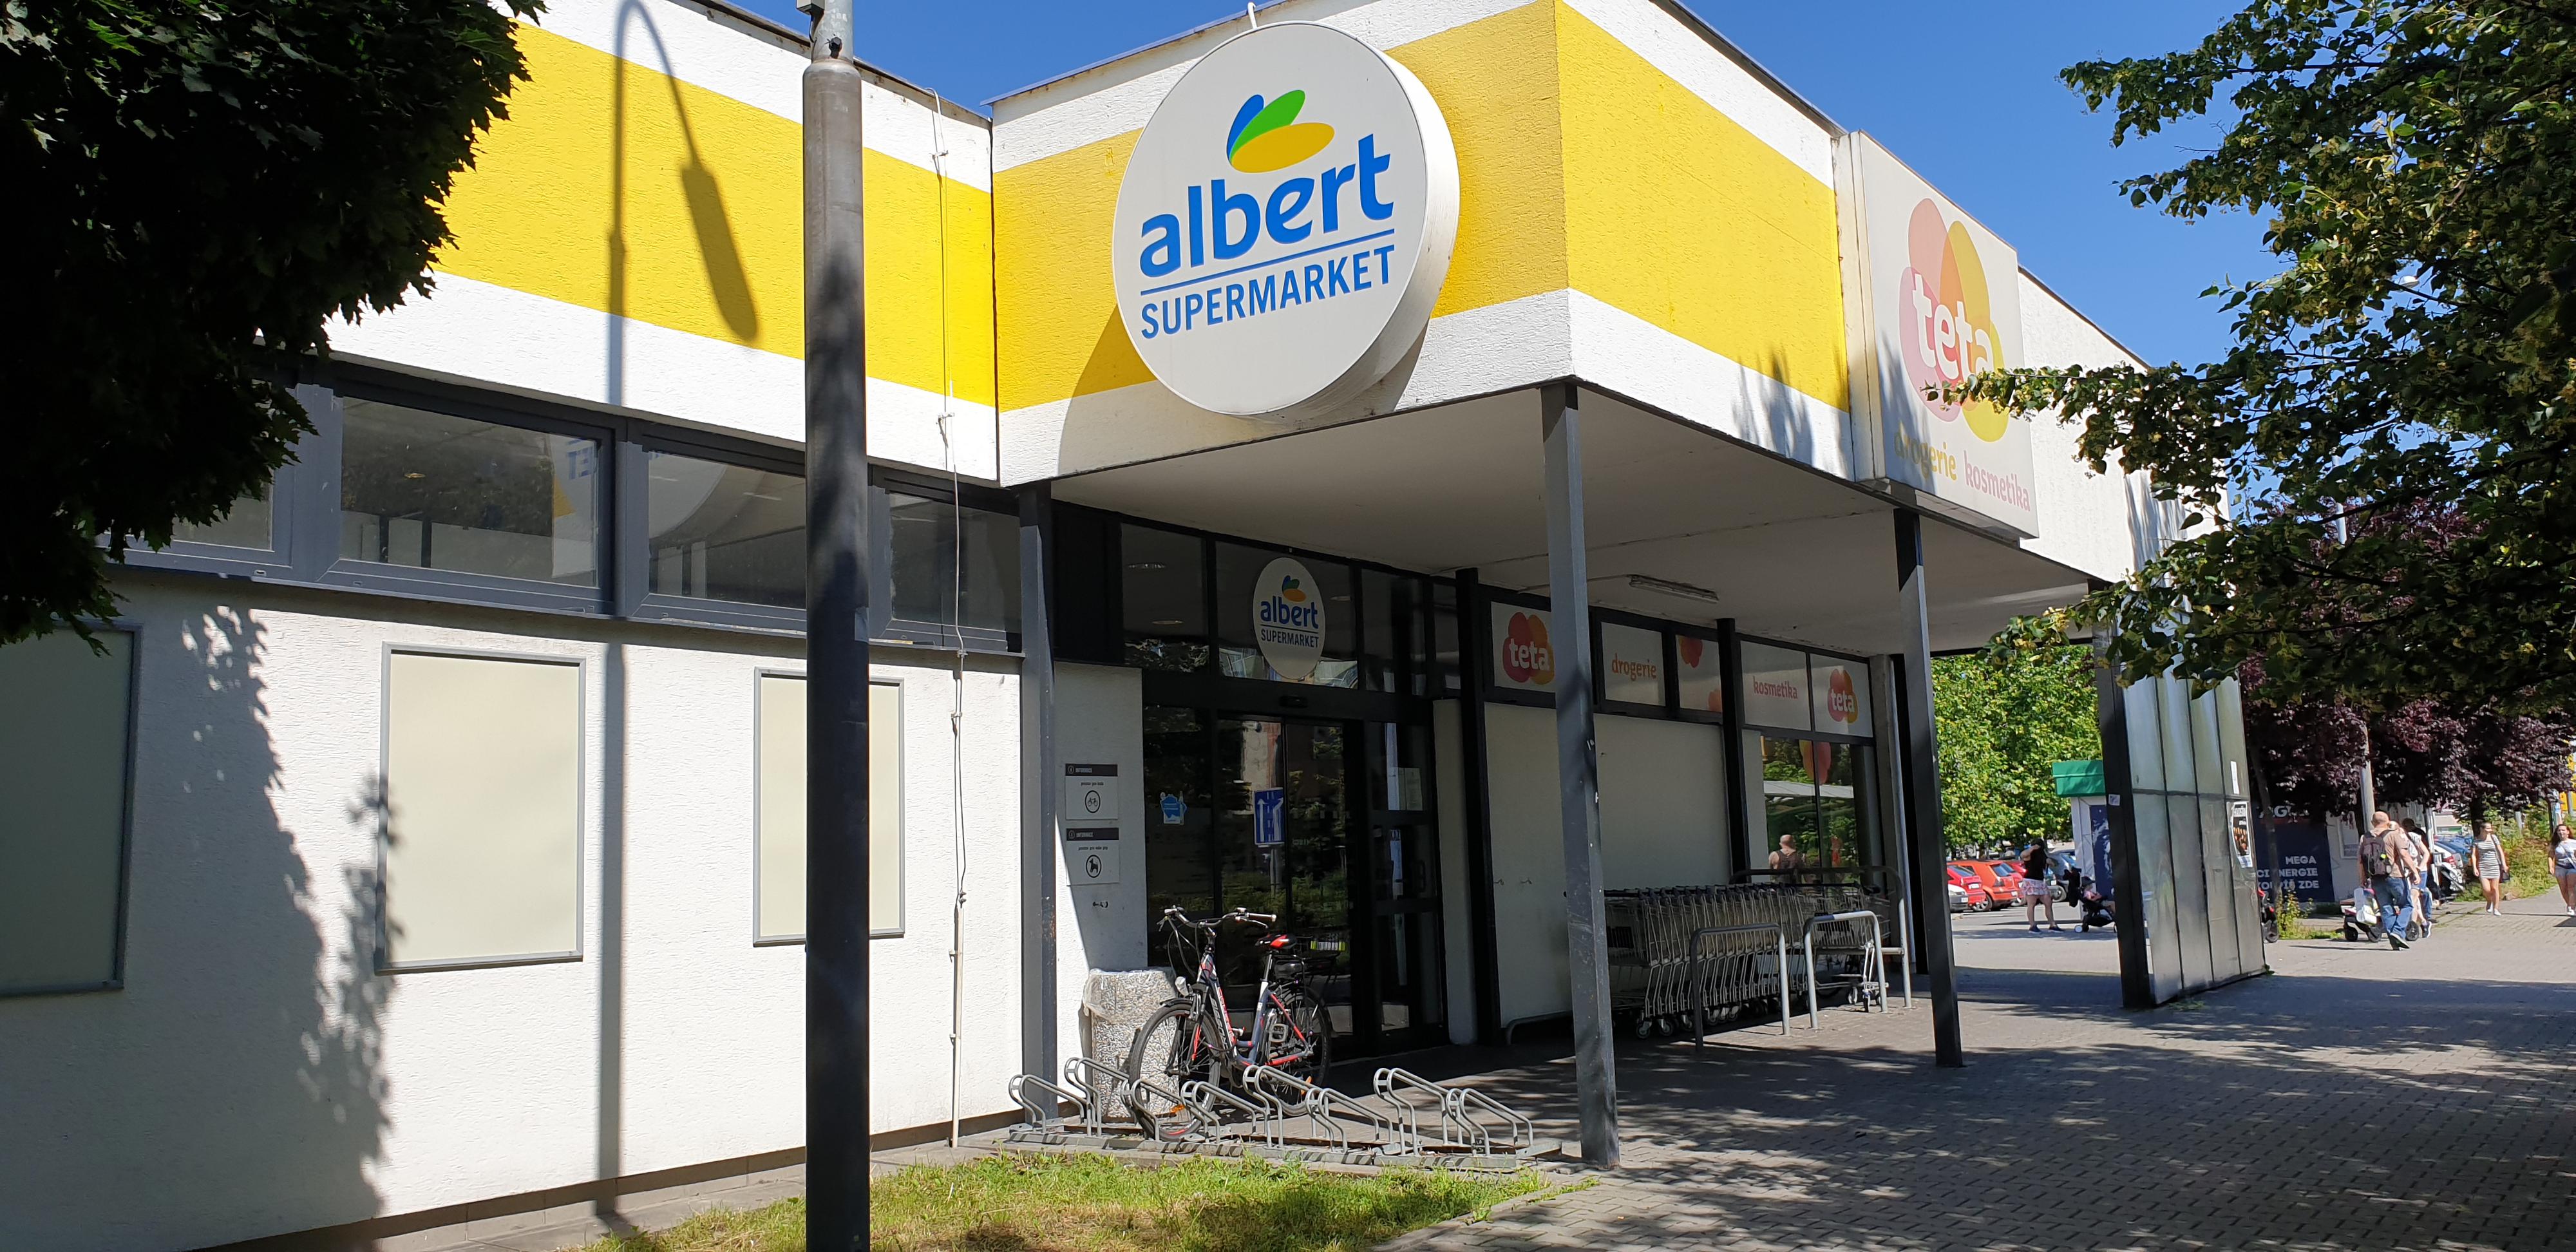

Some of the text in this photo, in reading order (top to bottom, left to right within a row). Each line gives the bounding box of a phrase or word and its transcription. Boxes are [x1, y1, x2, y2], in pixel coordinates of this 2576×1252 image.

[1140, 133, 1394, 278] albert
[1141, 244, 1395, 339] SUPERMARKET
[1912, 273, 1994, 383] teta
[1893, 420, 2031, 511] drogerie kosmetika
[1260, 595, 1319, 629] albert
[1260, 629, 1319, 649] SUPERMARKET
[1508, 638, 1550, 671] teta
[1611, 653, 1657, 681] drogerie
[1753, 676, 1798, 699] kosmetika
[1831, 688, 1855, 712] teta
[2278, 868, 2318, 877] NERGIE
[2285, 855, 2316, 864] MEGA
[2298, 880, 2319, 889] ZDE
